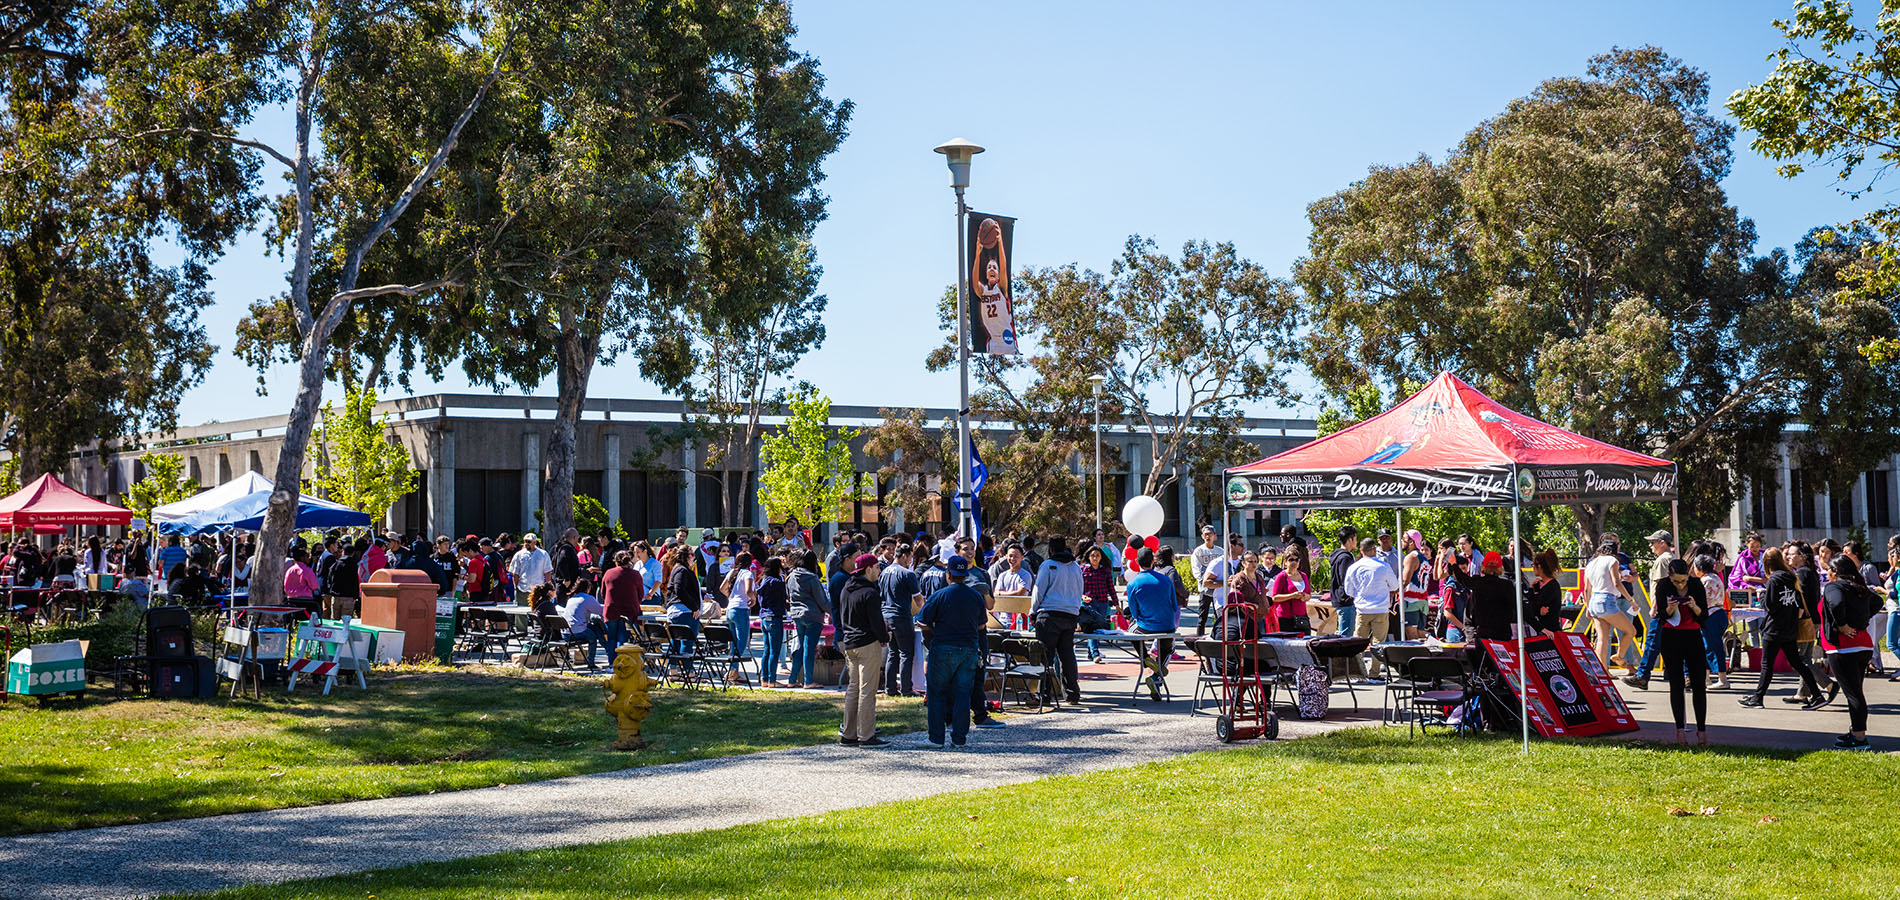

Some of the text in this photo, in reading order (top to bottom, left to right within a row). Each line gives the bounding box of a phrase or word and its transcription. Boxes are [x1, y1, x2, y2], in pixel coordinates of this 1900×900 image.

[986, 304, 998, 318] 22
[1257, 474, 1323, 484] CALIFORNIA STATE
[1536, 469, 1578, 478] CALIFORNIA STATE
[1333, 471, 1513, 503] Pioneers for Life!
[1538, 478, 1579, 492] UNIVERSITY
[1584, 469, 1676, 498] Pioneers for Life!
[1258, 484, 1323, 497] UNIVERSITY
[1297, 498, 1323, 506] BAY
